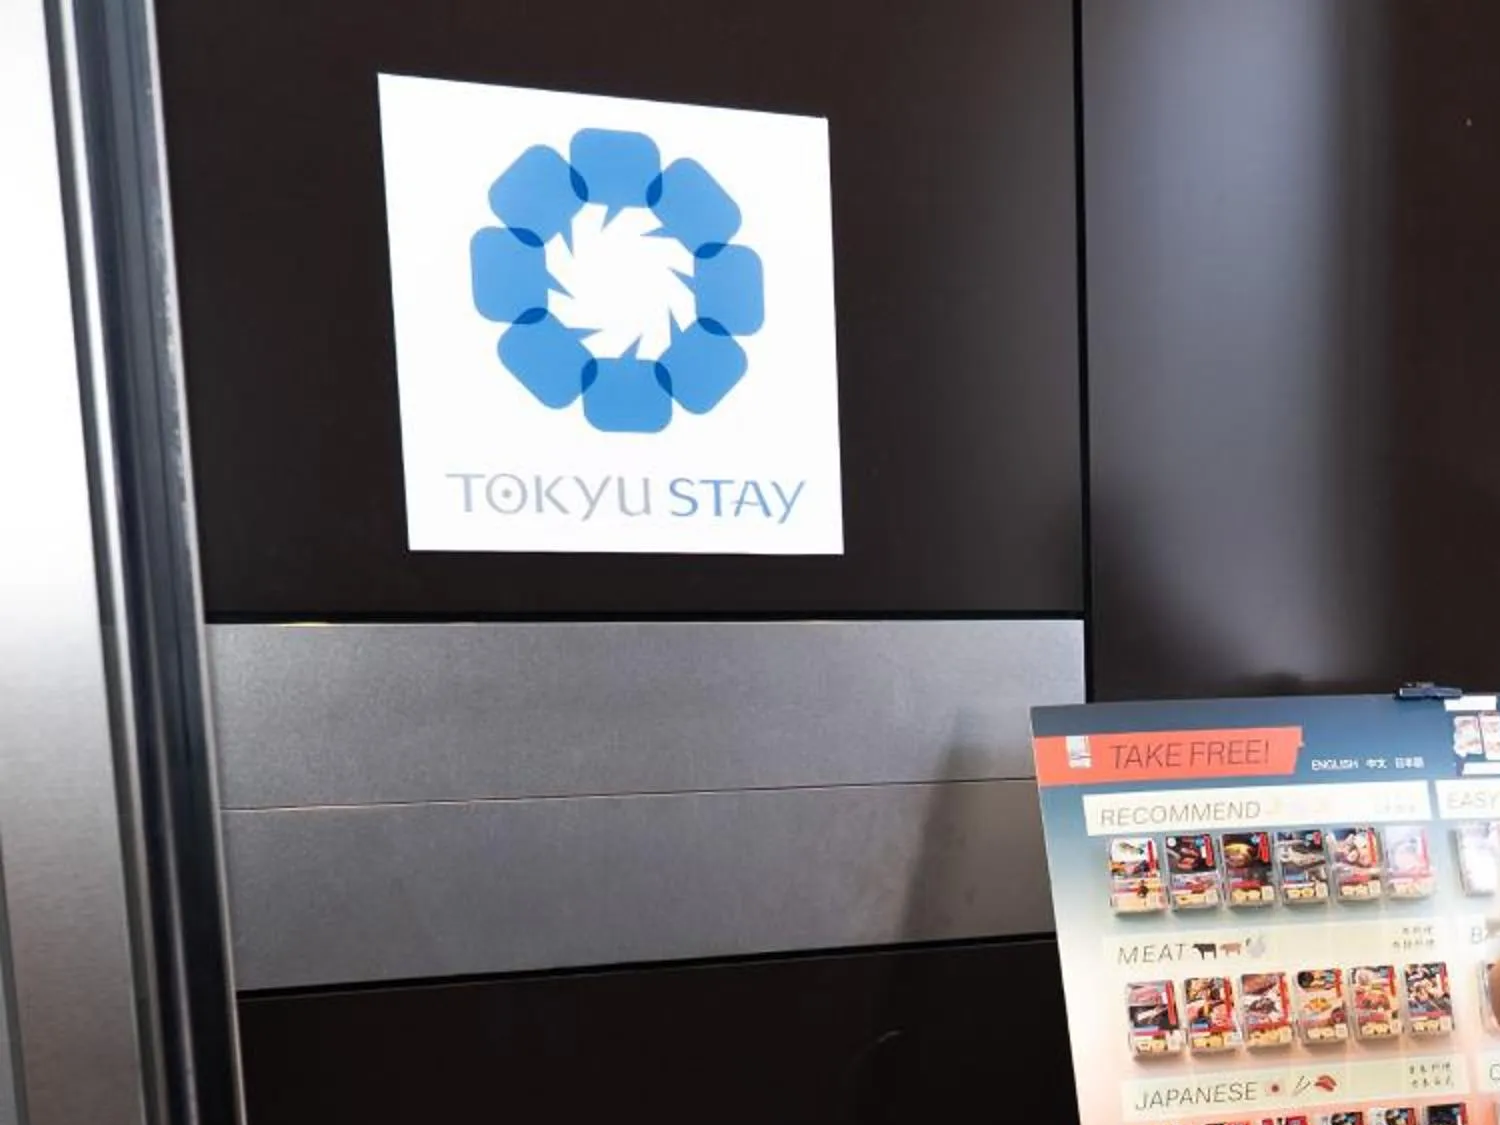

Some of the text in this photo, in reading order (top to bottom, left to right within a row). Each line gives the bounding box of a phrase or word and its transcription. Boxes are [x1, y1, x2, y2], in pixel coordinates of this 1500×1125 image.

[445, 473, 807, 524] TOKYU STAY
[1110, 739, 1270, 770] TAKE FREE!
[1311, 758, 1359, 771] ENGLISH
[1099, 801, 1261, 828] RECOMMEND
[1117, 943, 1187, 966] MEAT
[1134, 1081, 1258, 1111] JAPANESE
